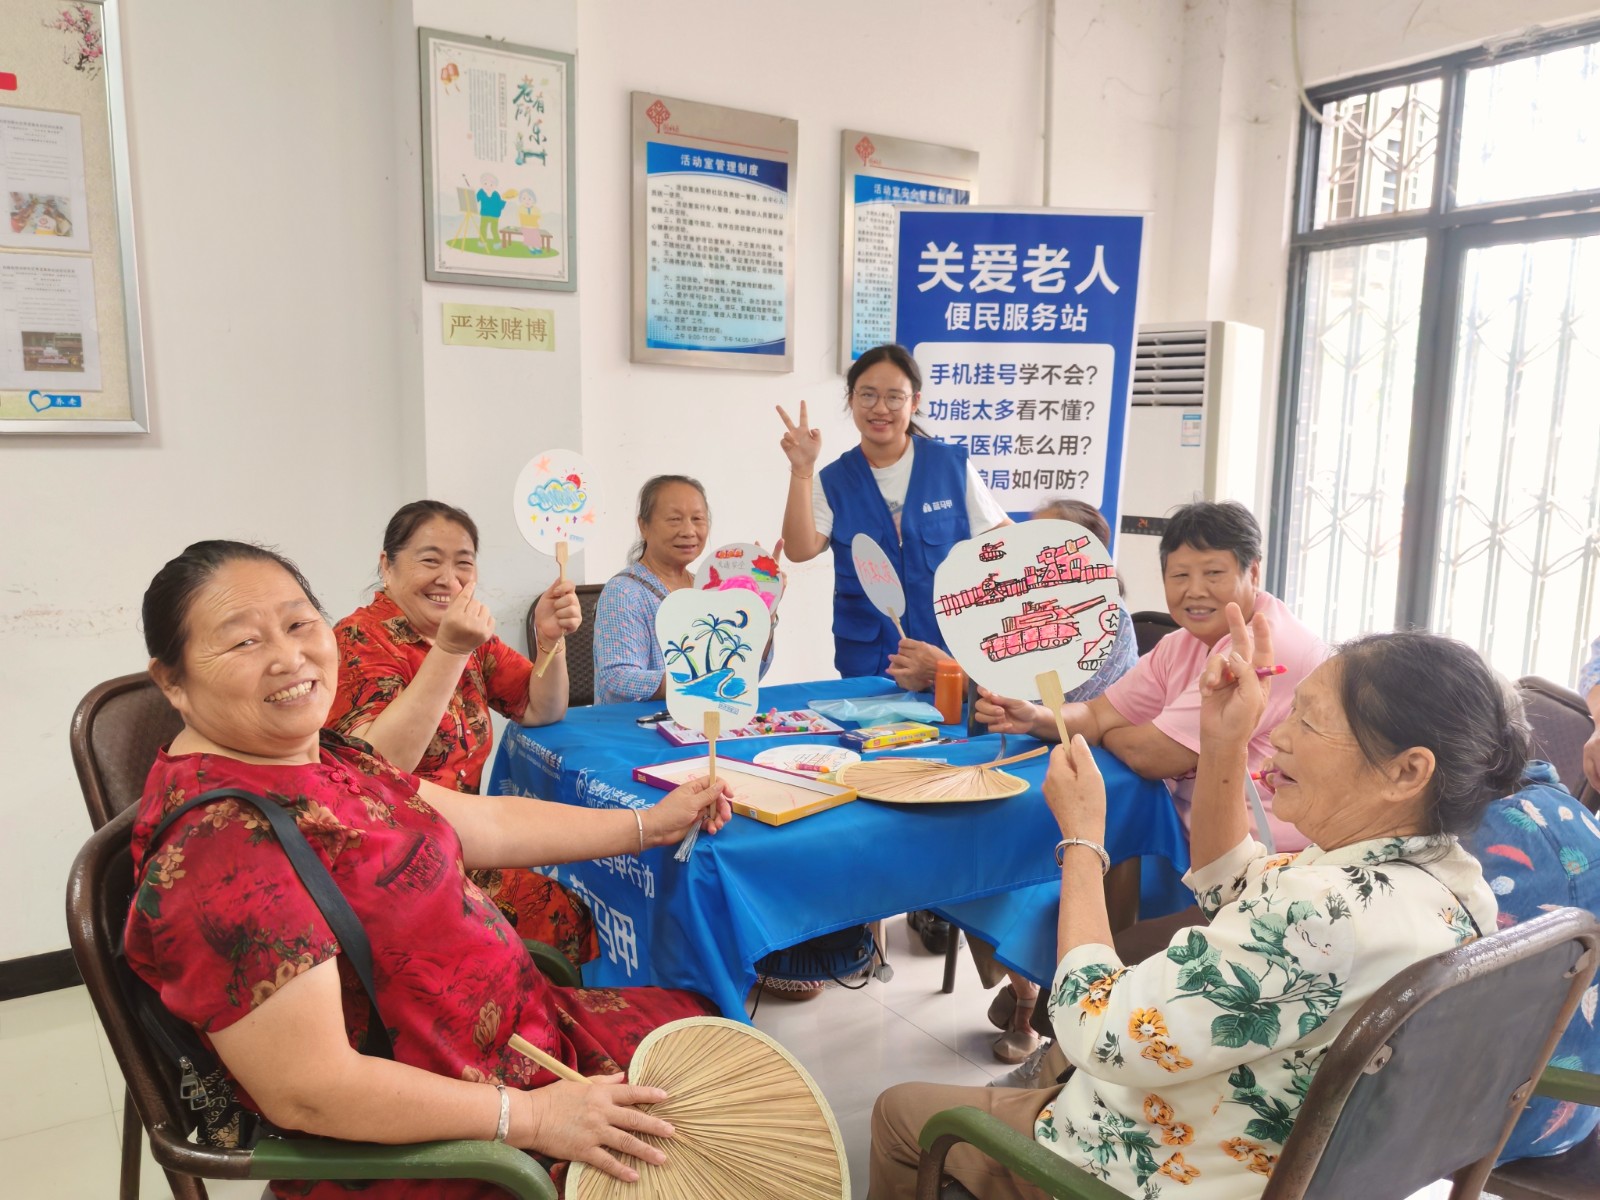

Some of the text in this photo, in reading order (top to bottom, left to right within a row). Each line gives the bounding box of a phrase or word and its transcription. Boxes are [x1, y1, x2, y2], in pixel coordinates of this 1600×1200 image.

[680, 153, 759, 177] 活动室管理制度
[917, 241, 1120, 295] 关爱老人
[449, 314, 549, 343] 严禁赌博
[945, 302, 1089, 332] 便民服务站
[929, 363, 1098, 387] 手机挂号学不会?
[928, 399, 1096, 422] 功能太多看不懂?
[932, 434, 1093, 456] 子医保怎么用?
[592, 854, 655, 899] 马甲行动
